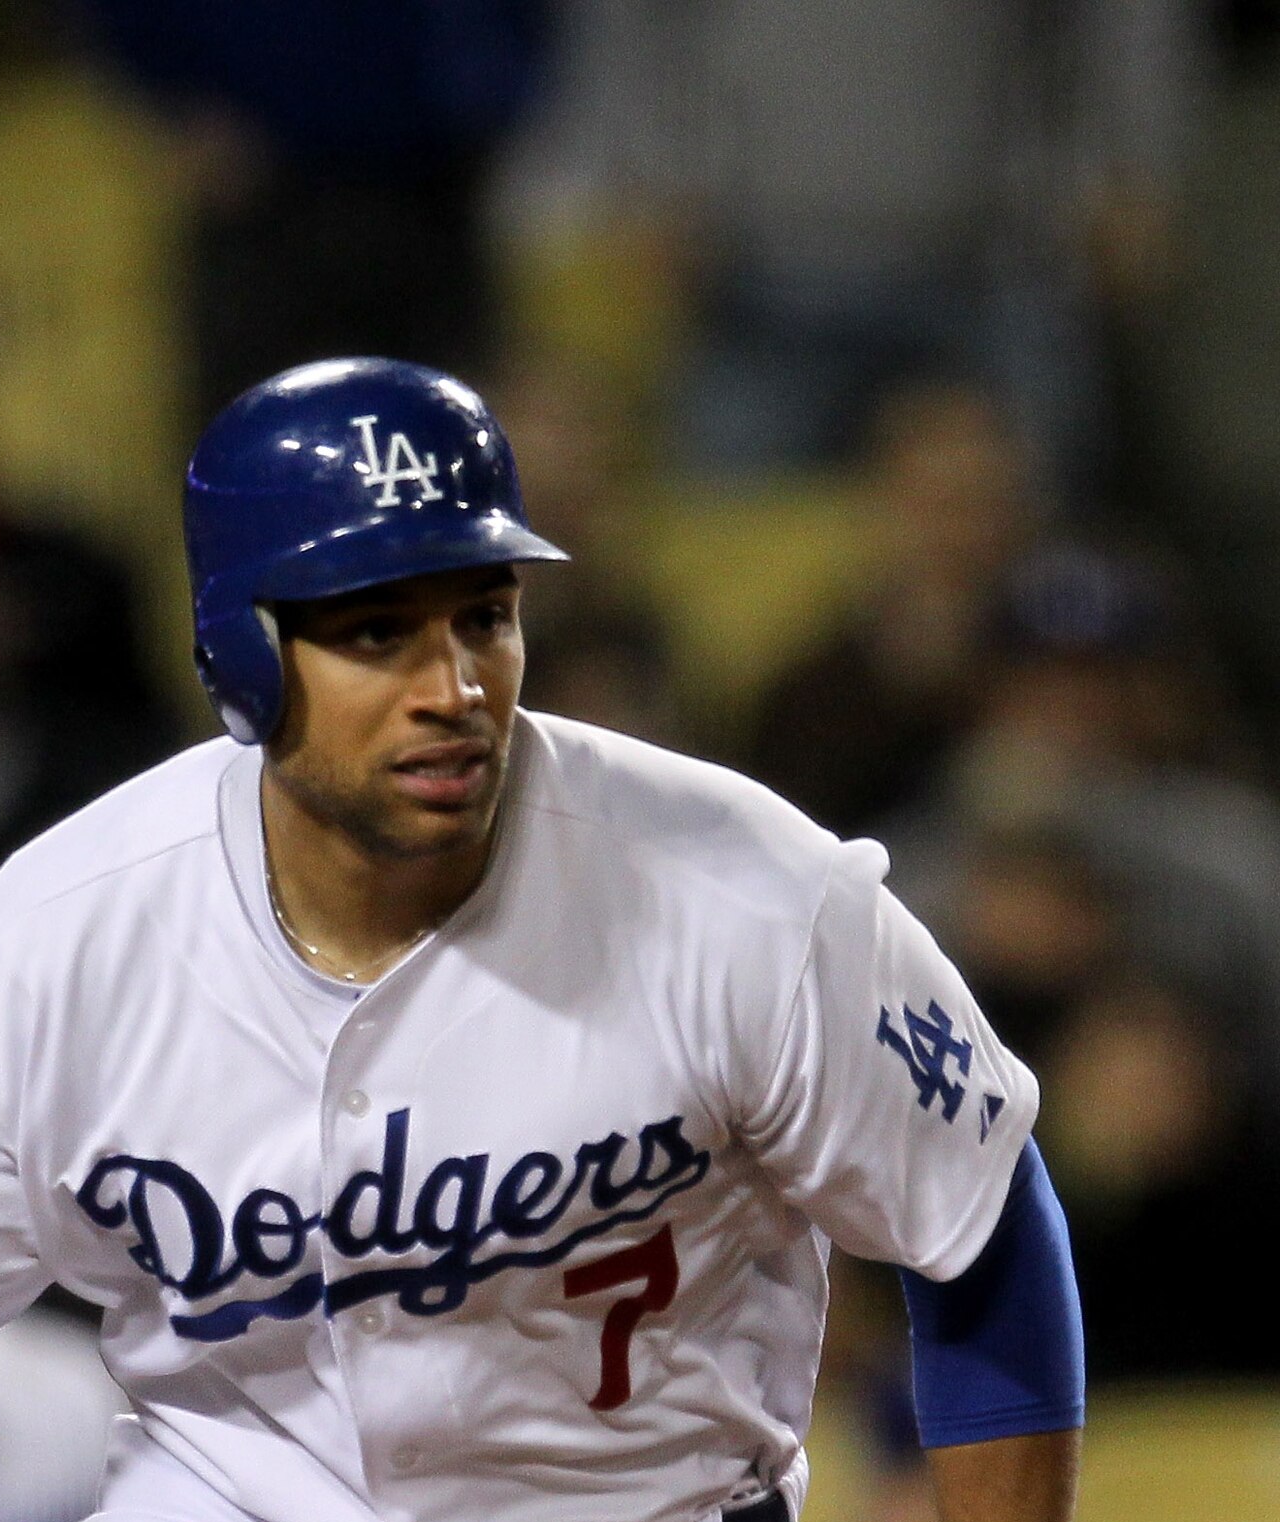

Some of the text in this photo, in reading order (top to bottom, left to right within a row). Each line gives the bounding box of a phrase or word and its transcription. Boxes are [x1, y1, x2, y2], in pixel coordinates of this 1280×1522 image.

[350, 415, 443, 507] LA
[876, 999, 972, 1124] LA
[78, 1107, 711, 1320] Dodgers
[563, 1223, 679, 1412] 7
